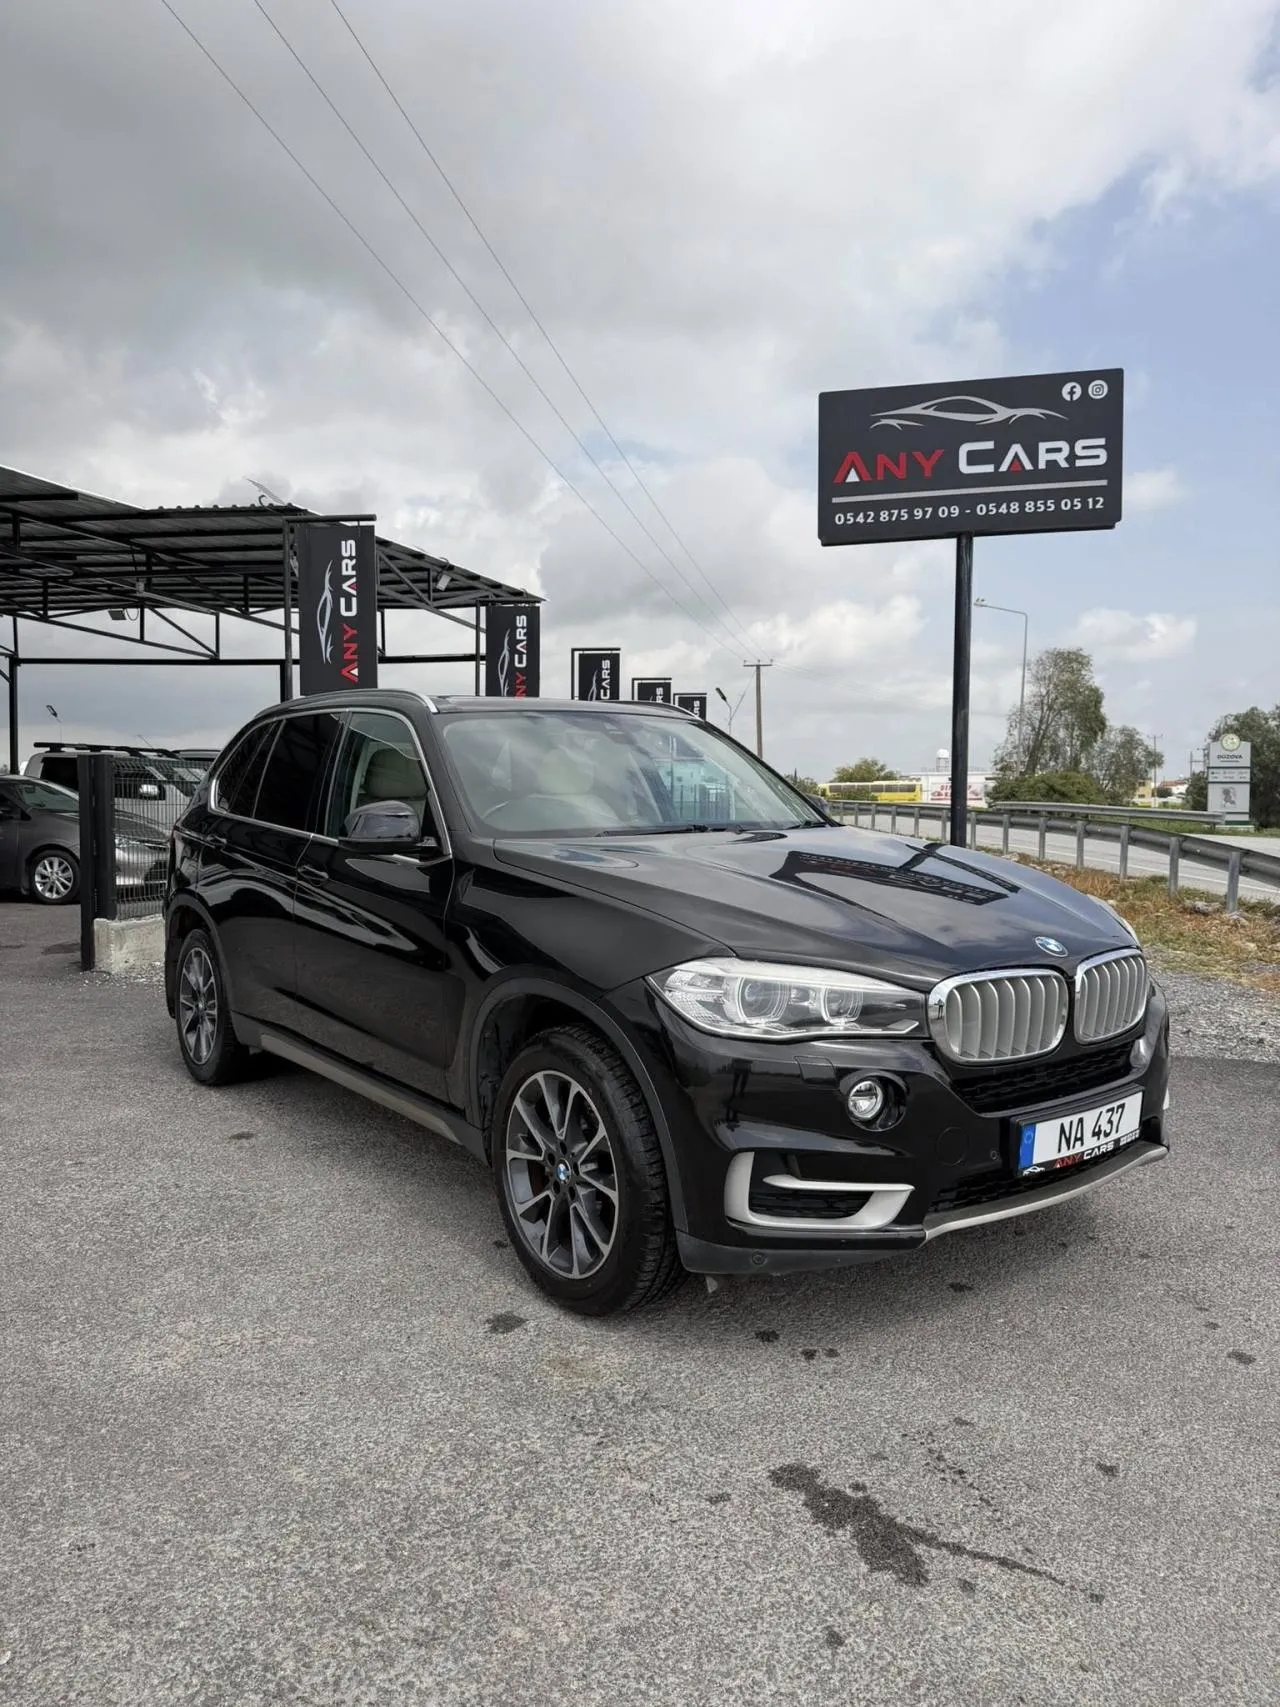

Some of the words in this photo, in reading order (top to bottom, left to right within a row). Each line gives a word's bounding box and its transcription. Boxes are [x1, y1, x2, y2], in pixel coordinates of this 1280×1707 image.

[832, 450, 944, 484] ANY
[958, 438, 1108, 474] CARS
[835, 511, 874, 525] 0542
[880, 509, 908, 522] 875
[914, 508, 932, 520] 97
[939, 506, 959, 518] 09
[976, 501, 1019, 515] 0548
[1025, 499, 1055, 513] 855
[1061, 498, 1081, 511] 05
[1088, 497, 1104, 510] 12
[340, 539, 357, 617] CARS
[340, 624, 358, 684] ANY
[514, 615, 527, 668] CARS
[515, 672, 527, 700] NY
[600, 660, 610, 700] CARS
[1058, 1117, 1084, 1153] NA
[1091, 1102, 1125, 1141] 437
[1053, 1154, 1083, 1168] ANY
[1083, 1141, 1114, 1160] CARS
